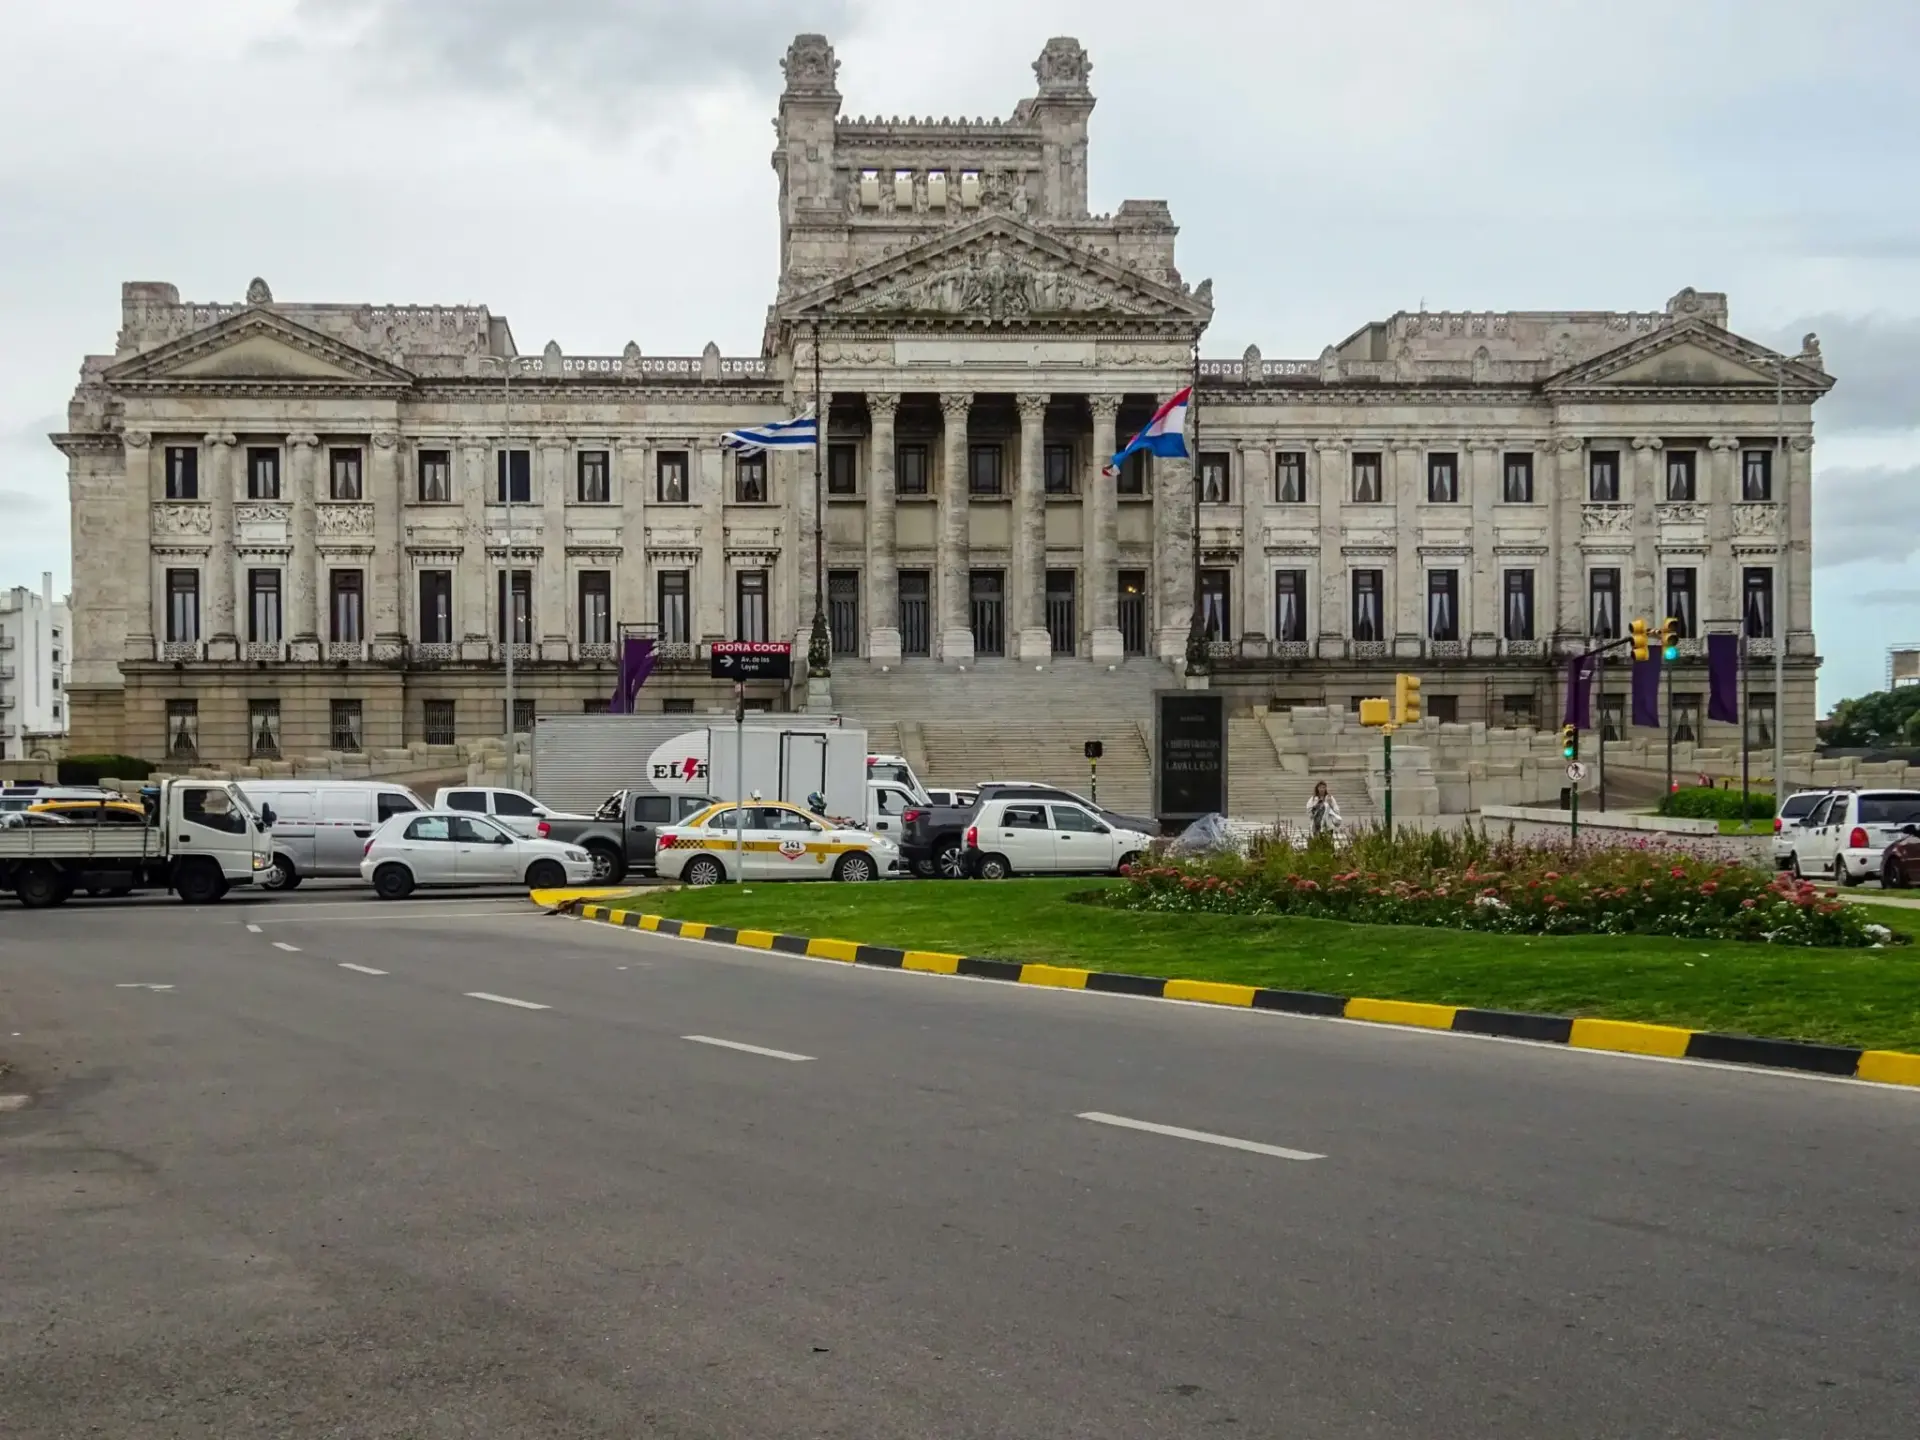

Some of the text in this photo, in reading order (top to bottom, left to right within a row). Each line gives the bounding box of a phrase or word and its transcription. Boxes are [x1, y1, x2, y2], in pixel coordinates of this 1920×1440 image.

[753, 644, 785, 652] COCA
[731, 841, 755, 850] TXI
[785, 841, 800, 849] 141
